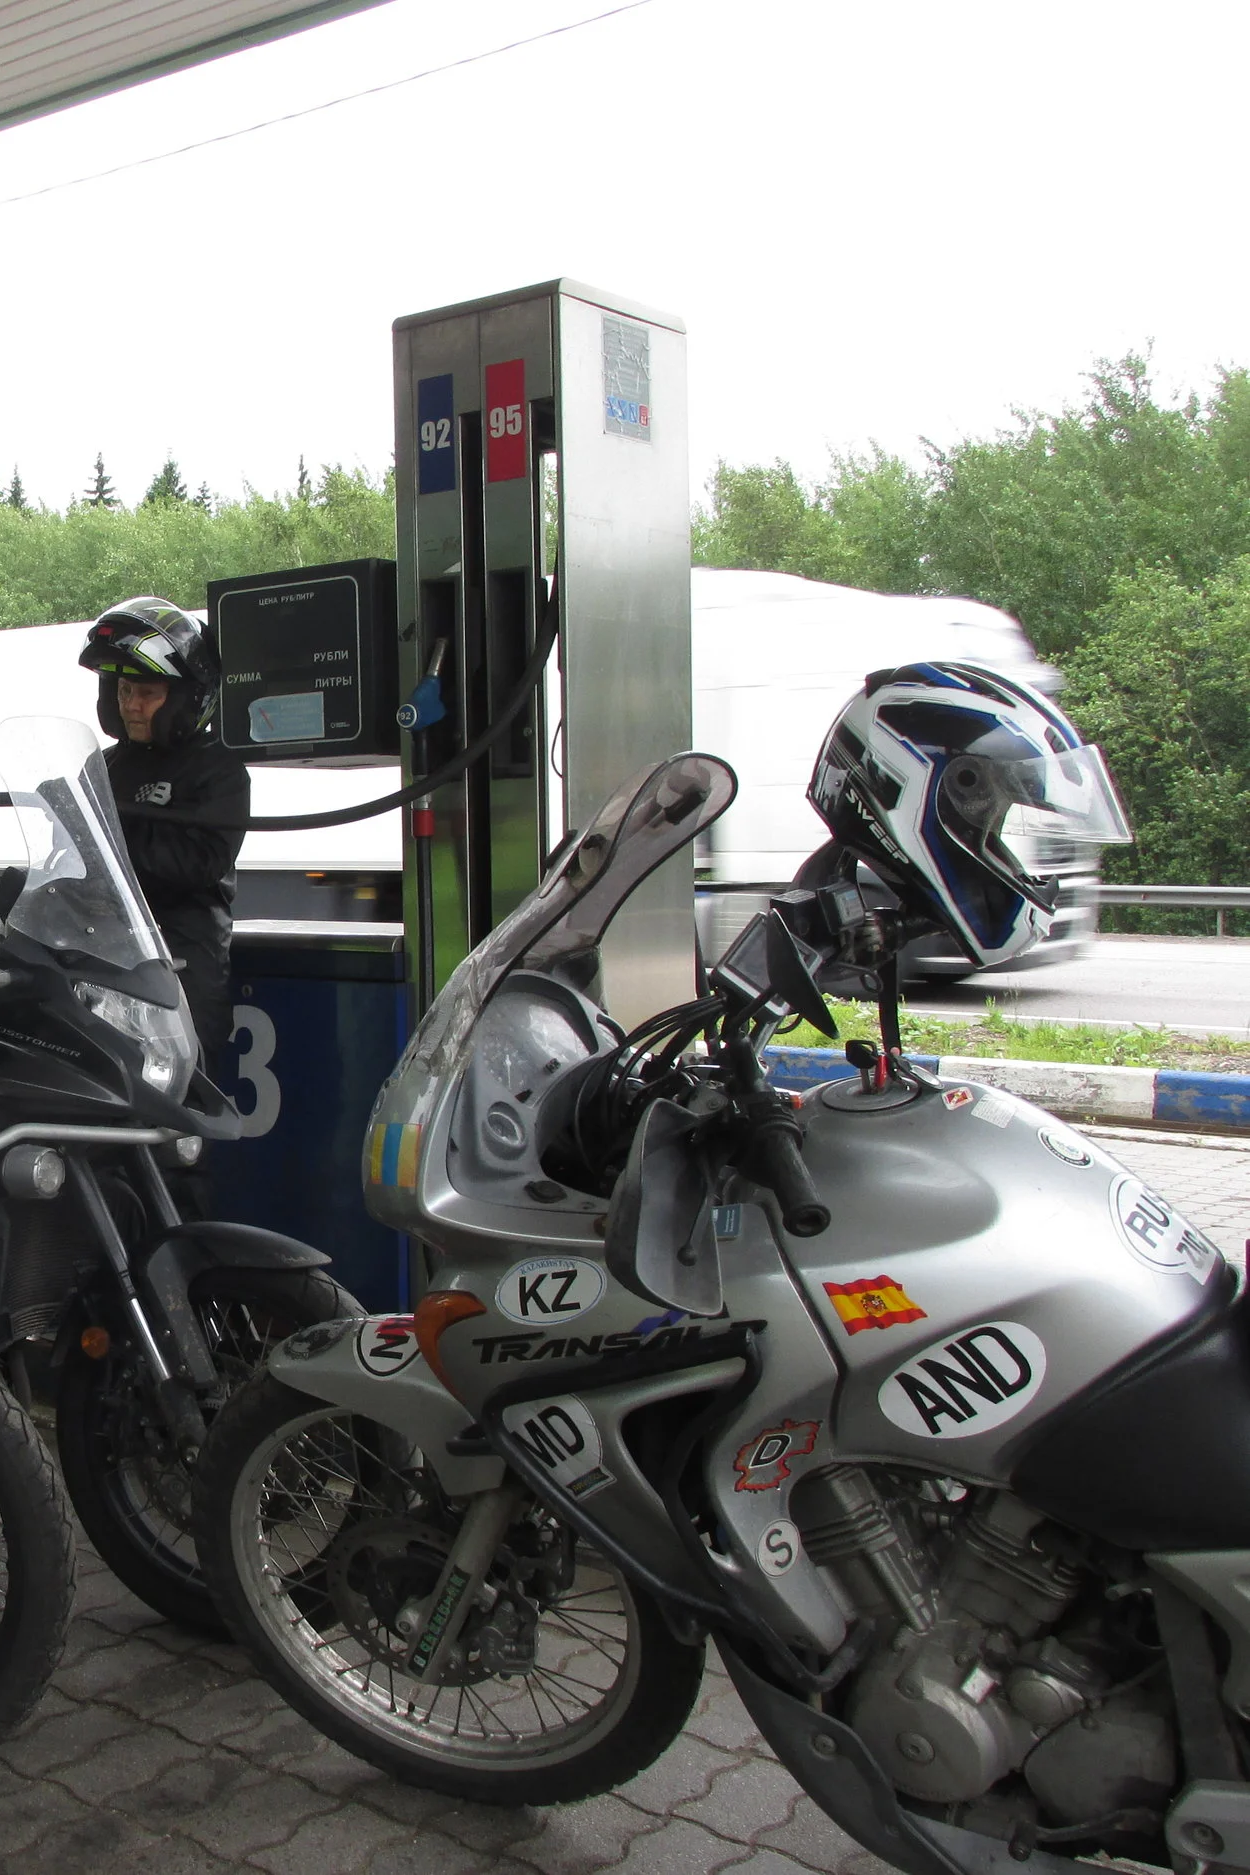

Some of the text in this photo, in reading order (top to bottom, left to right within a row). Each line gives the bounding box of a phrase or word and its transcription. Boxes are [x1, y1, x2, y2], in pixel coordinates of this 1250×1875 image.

[420, 418, 451, 452] 92
[490, 403, 522, 438] 95
[259, 597, 278, 606] ЦЕНА
[313, 650, 349, 662] РУБЛИ
[226, 671, 262, 684] СУММА
[314, 675, 352, 689] ЛИТРЫ
[227, 1004, 282, 1138] 3
[1124, 1185, 1173, 1249] RUS
[518, 1269, 581, 1317] KZ
[894, 1326, 1032, 1435] AND
[510, 1405, 585, 1469] MD
[750, 1433, 792, 1469] D
[765, 1528, 793, 1569] S
